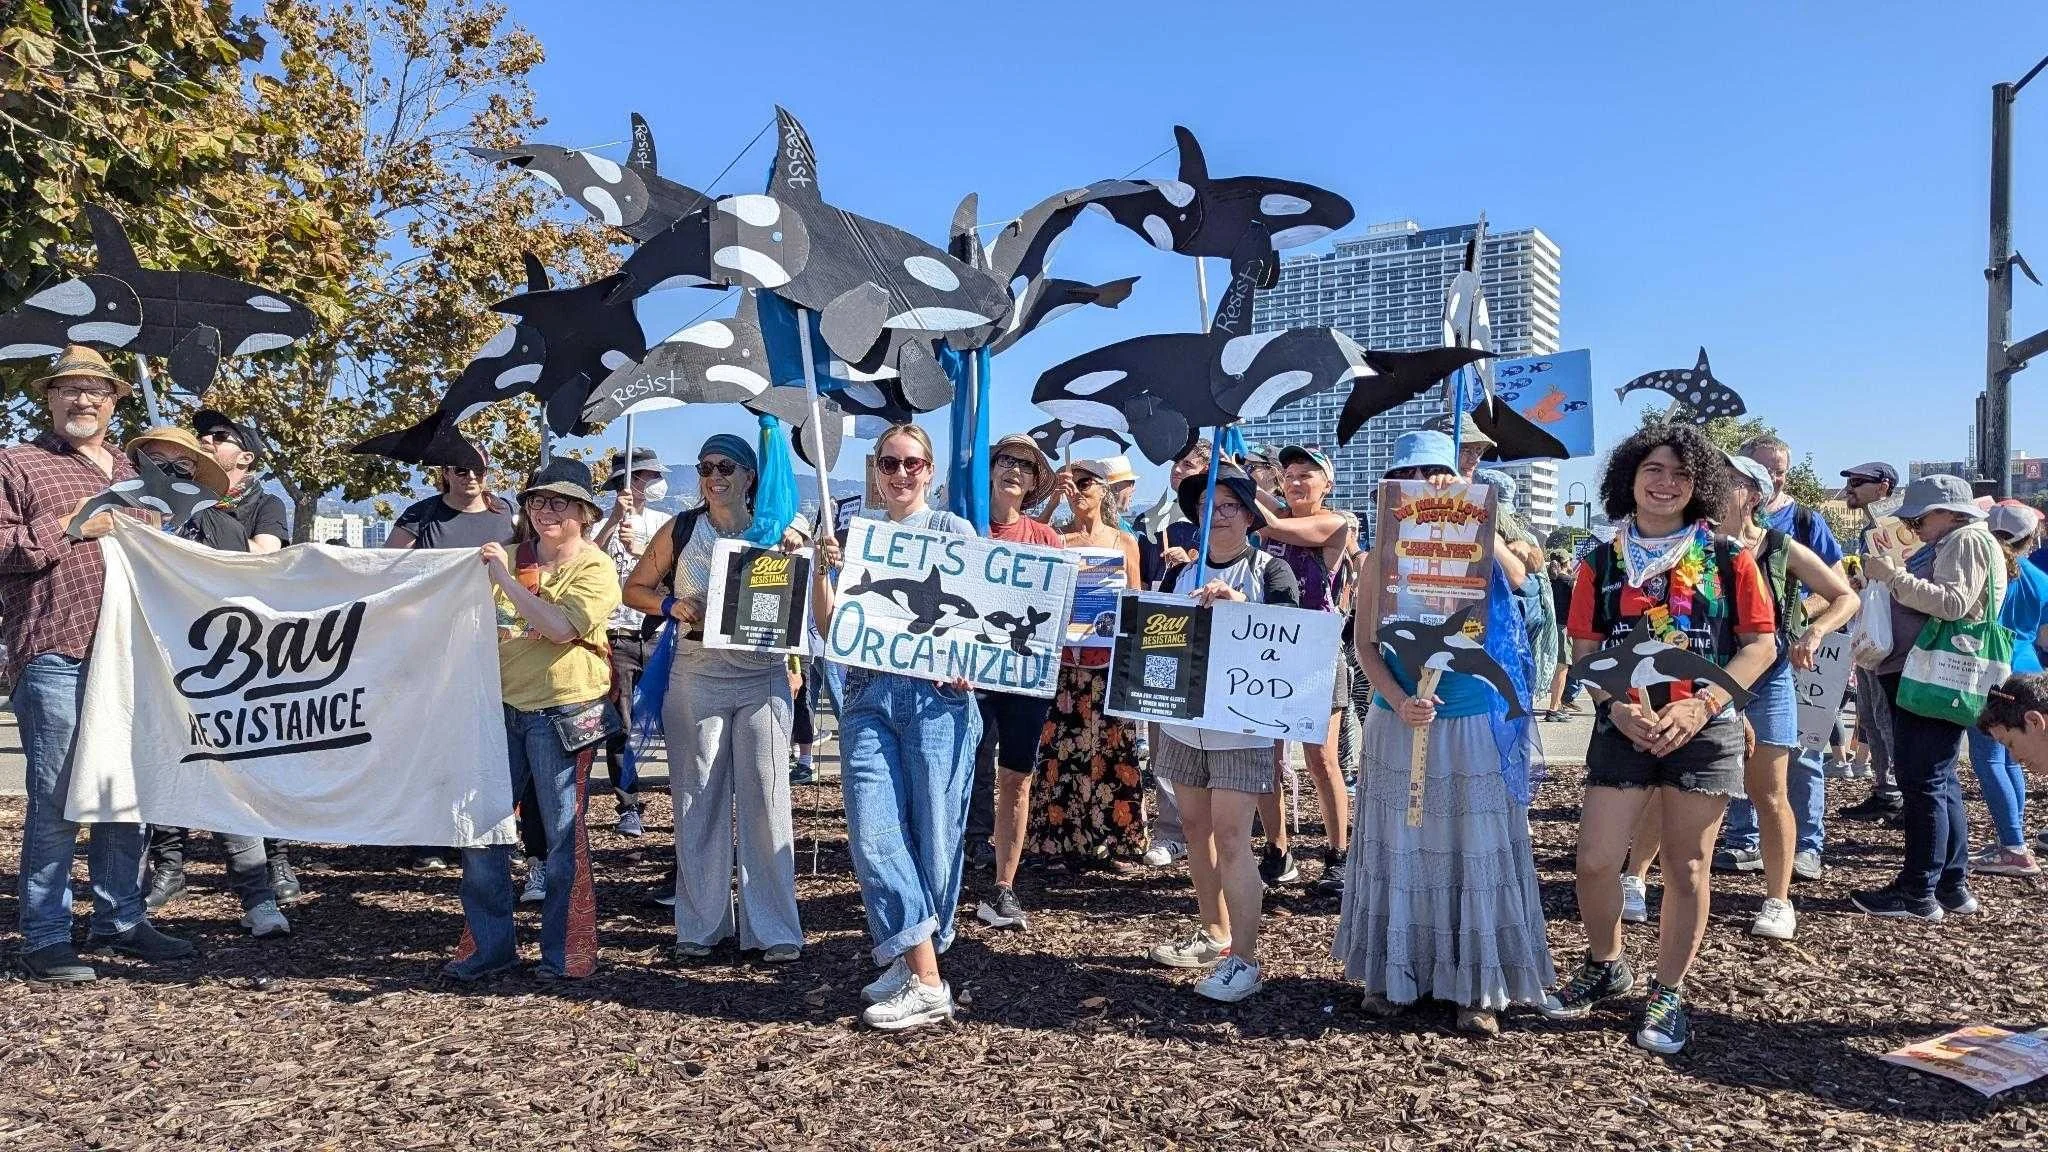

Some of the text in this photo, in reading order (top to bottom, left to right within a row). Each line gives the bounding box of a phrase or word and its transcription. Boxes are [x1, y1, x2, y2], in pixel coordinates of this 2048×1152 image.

[634, 124, 651, 168] Resist
[1216, 266, 1257, 334] Resist
[611, 369, 682, 408] Resist
[1394, 504, 1414, 522] WE
[1415, 498, 1454, 512] HELLA
[1416, 510, 1468, 525] JUSTICE
[752, 556, 791, 574] Bay
[862, 524, 1063, 592] LET'S GET
[750, 573, 789, 584] RESISTANCE
[1143, 613, 1189, 635] Bay
[1231, 614, 1300, 645] JOIN
[173, 601, 367, 701] Bay
[1142, 633, 1187, 646] RESISTANCE
[1261, 648, 1280, 661] a
[1813, 646, 1840, 661] IN
[1226, 667, 1294, 699] POD
[188, 687, 366, 748] RESISTANCE
